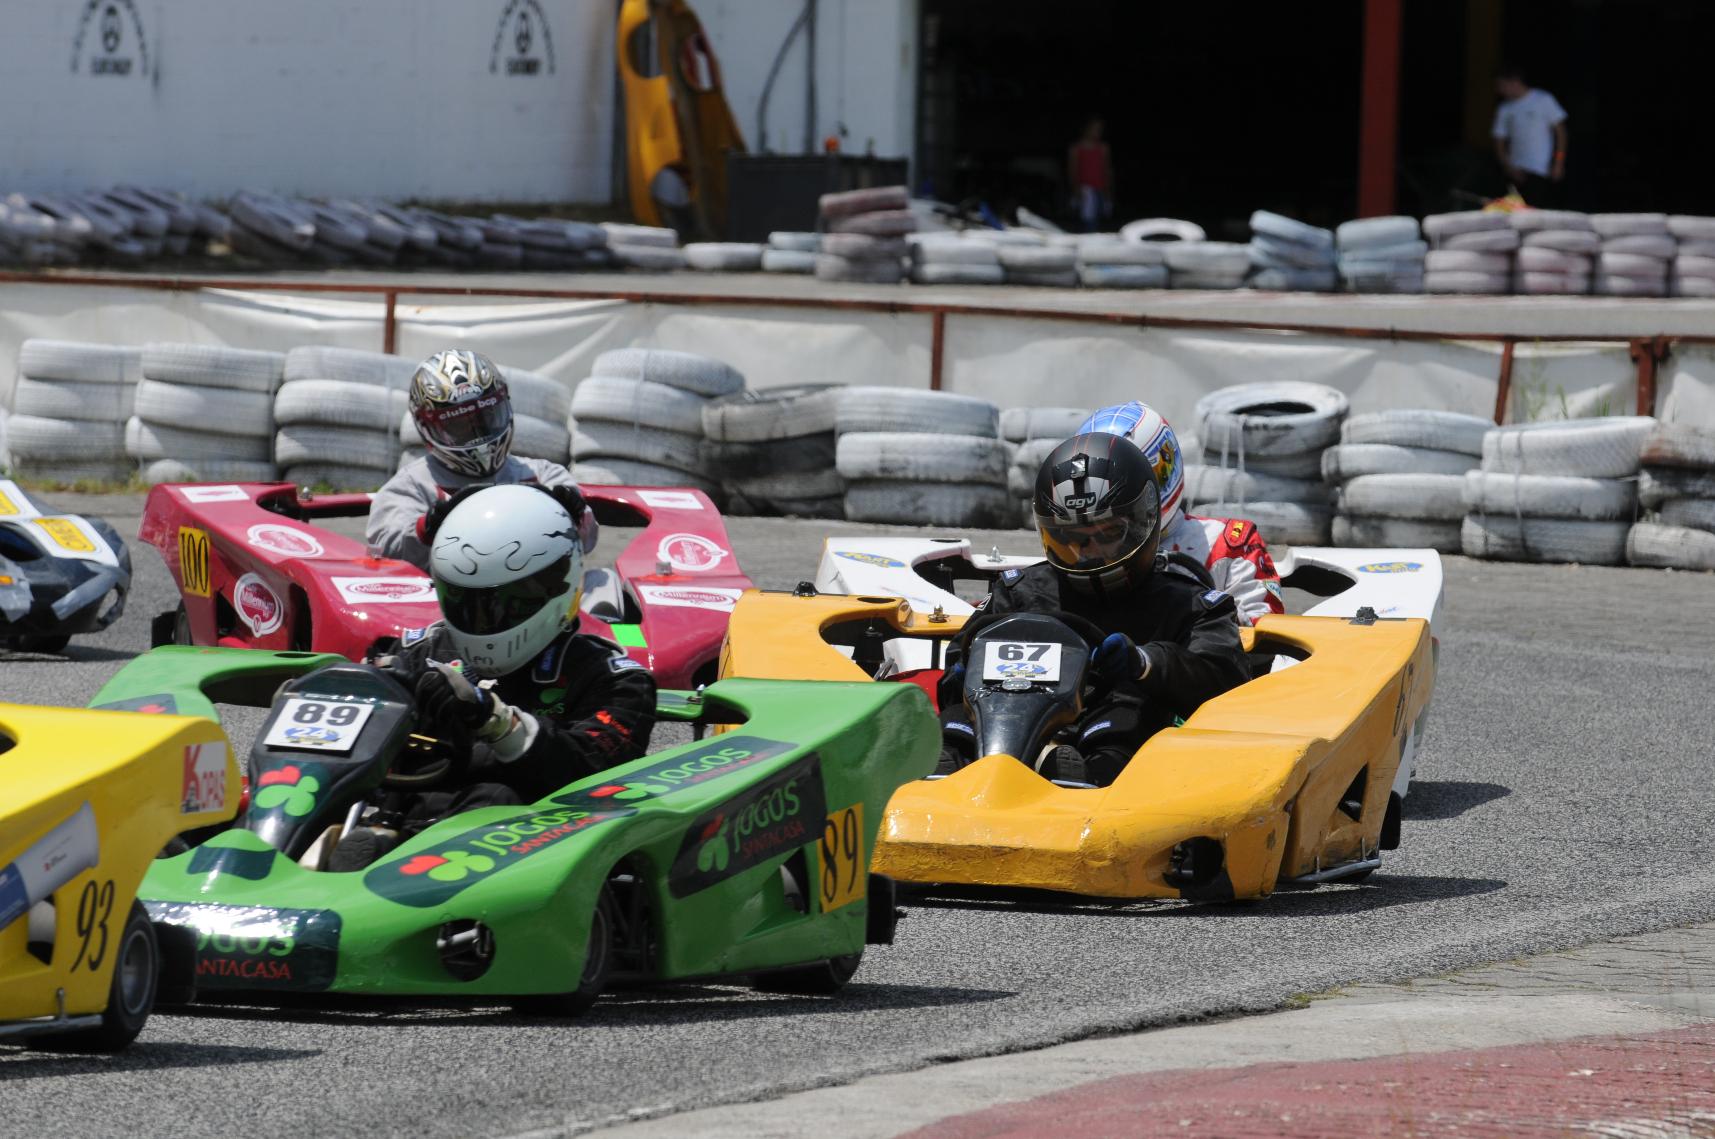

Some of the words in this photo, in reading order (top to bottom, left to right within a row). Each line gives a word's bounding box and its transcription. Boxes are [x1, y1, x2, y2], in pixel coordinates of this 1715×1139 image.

[438, 405, 476, 420] clube
[477, 396, 498, 409] bcp
[1065, 495, 1096, 509] agv
[181, 533, 209, 593] 100
[998, 643, 1052, 662] 67
[292, 702, 361, 727] 89
[647, 748, 752, 785] JOGOS
[469, 810, 591, 856] JOGOS
[510, 815, 609, 856] SANTACASA
[733, 777, 800, 854] JOGOS
[822, 808, 858, 904] 89
[69, 879, 115, 974] 93
